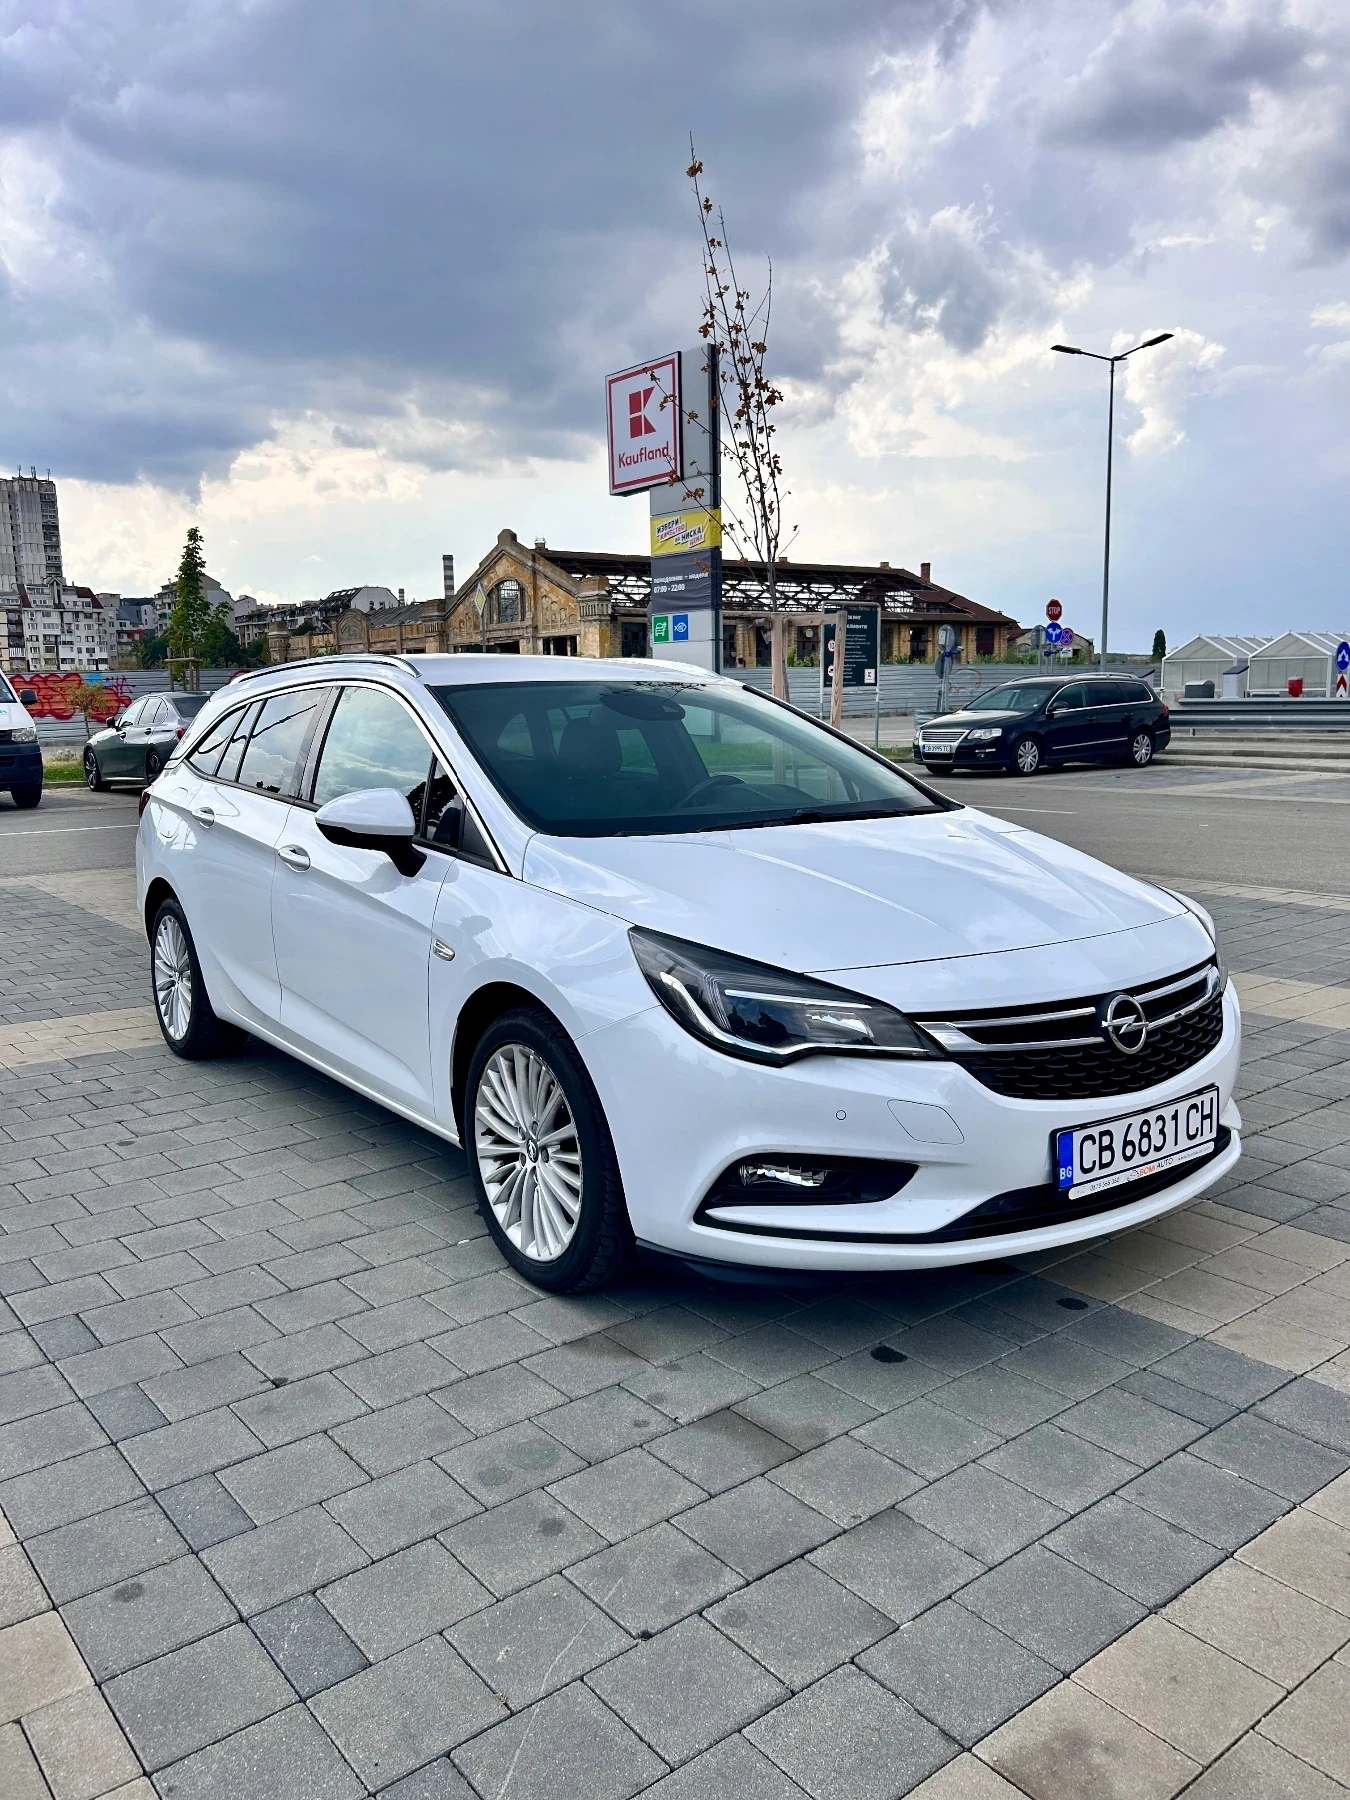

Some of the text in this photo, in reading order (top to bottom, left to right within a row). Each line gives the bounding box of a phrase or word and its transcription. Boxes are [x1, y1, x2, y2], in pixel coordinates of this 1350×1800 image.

[618, 441, 669, 468] Kaufland
[657, 518, 679, 534] ИЗБЕРИ
[660, 523, 685, 540] КАЧЕСТВО
[681, 526, 702, 541] НИСКА
[671, 583, 685, 592] 22:00
[1048, 606, 1061, 615] STOP
[1079, 1096, 1215, 1174] CB 6831 CH
[1156, 1157, 1174, 1169] AUTO
[1059, 1165, 1073, 1180] BG
